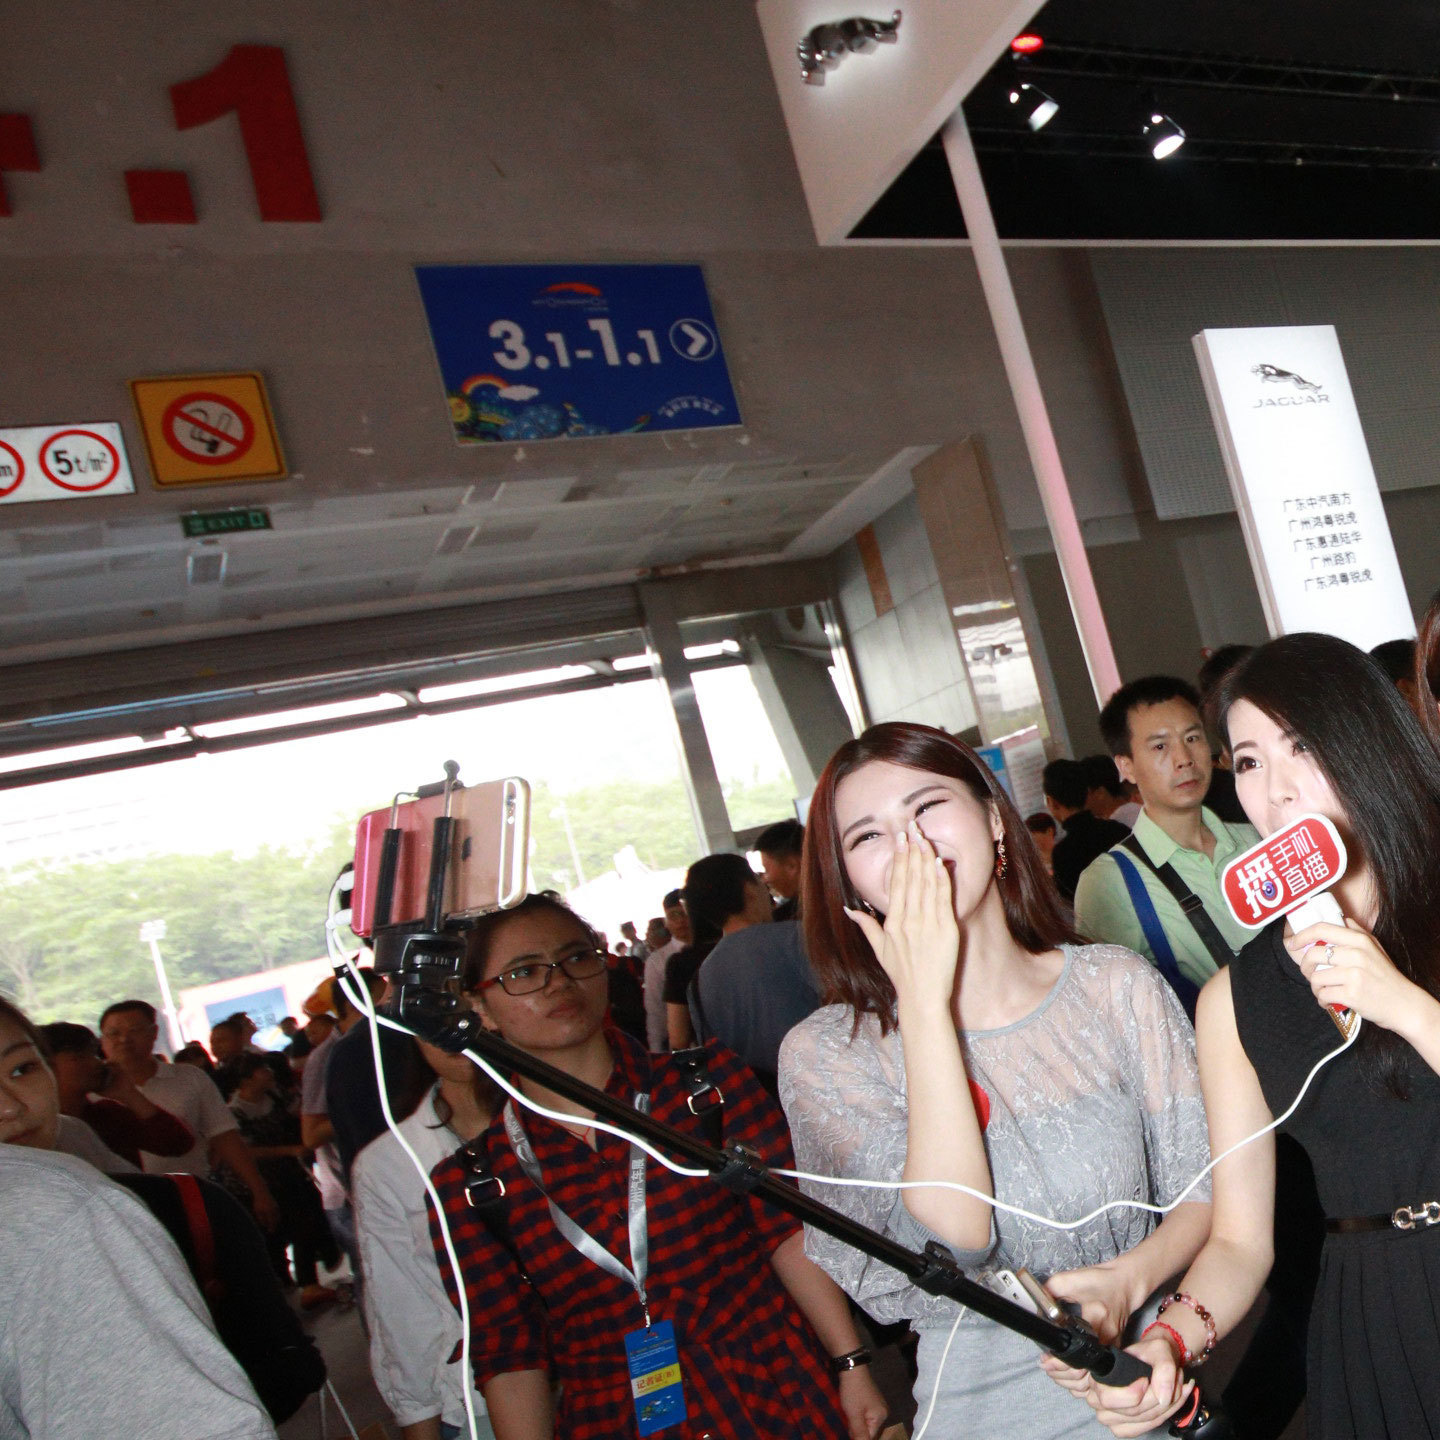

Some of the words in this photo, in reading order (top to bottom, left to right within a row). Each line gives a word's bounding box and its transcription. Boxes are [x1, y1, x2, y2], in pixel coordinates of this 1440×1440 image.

[489, 318, 662, 371] 3.1-1.1
[1252, 394, 1331, 409] JAGUAR
[1282, 492, 1352, 512] 广东中汽南方
[1270, 825, 1318, 872] 手机
[1282, 850, 1330, 897] 直播
